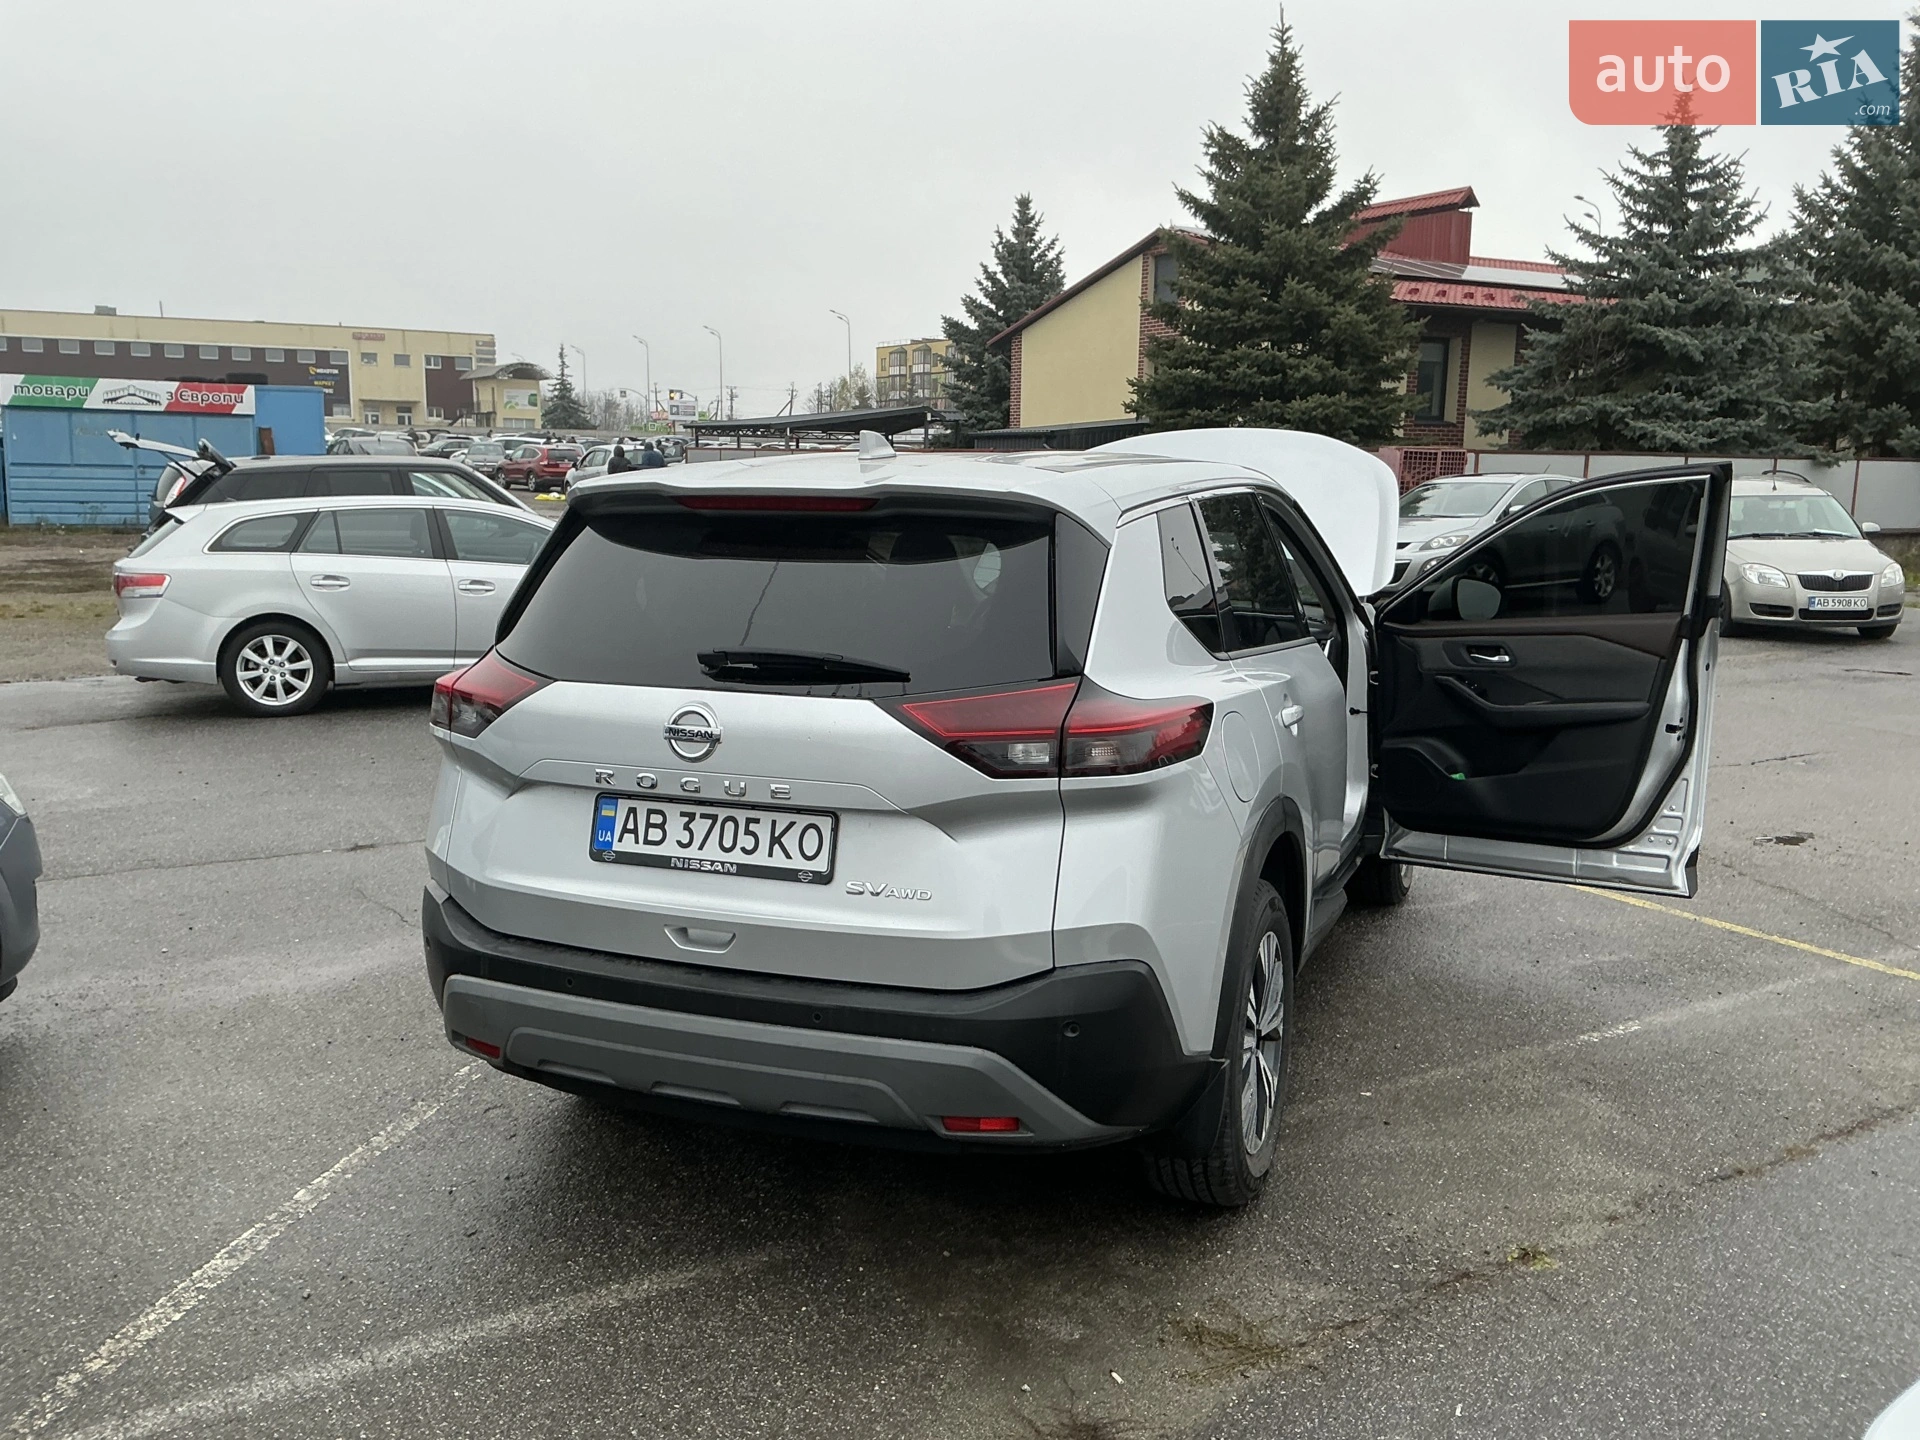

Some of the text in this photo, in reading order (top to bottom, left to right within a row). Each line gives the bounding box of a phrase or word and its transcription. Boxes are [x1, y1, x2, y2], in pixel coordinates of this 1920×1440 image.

[13, 383, 90, 399] товари
[179, 387, 244, 406] Європи
[1817, 598, 1829, 607] AB
[1831, 598, 1852, 607] 5908
[1853, 598, 1866, 607] KO
[667, 728, 714, 740] NISSAN
[595, 768, 792, 800] ROGUE
[598, 829, 612, 842] UA
[617, 806, 824, 862] AB 3705 KO
[670, 857, 737, 874] NISSAN
